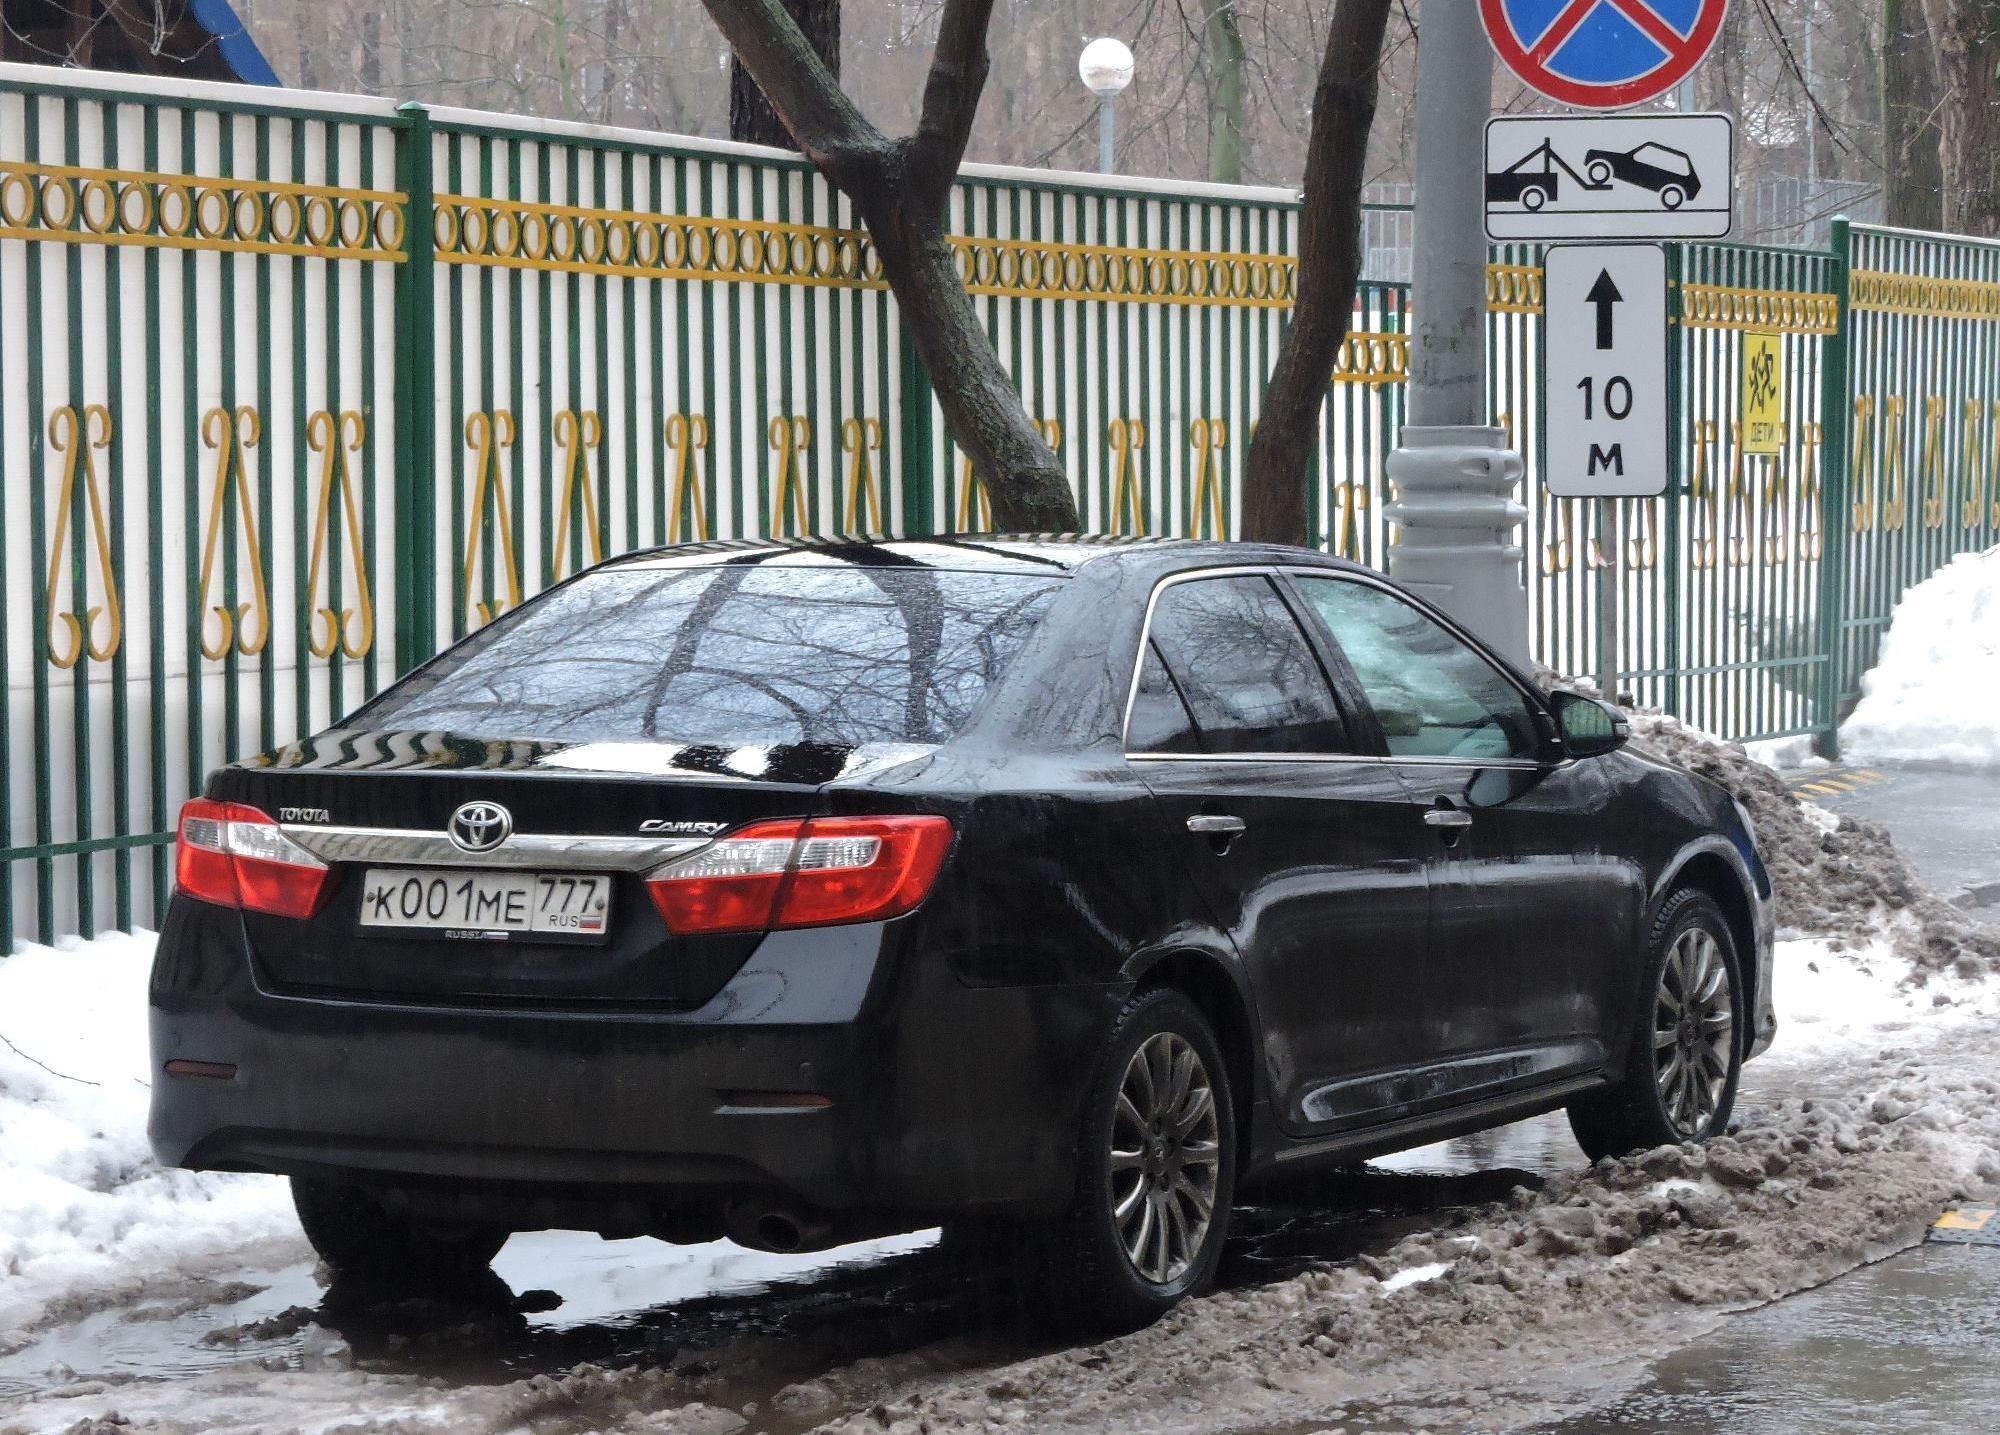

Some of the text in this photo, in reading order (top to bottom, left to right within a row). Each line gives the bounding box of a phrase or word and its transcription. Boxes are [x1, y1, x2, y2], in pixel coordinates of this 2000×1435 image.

[1576, 375, 1633, 421] 10
[1751, 422, 1774, 444] ДЕТИ
[279, 807, 330, 823] TOYOTA
[639, 819, 728, 835] CAMRY
[540, 879, 597, 914] 777
[549, 915, 578, 928] RUS
